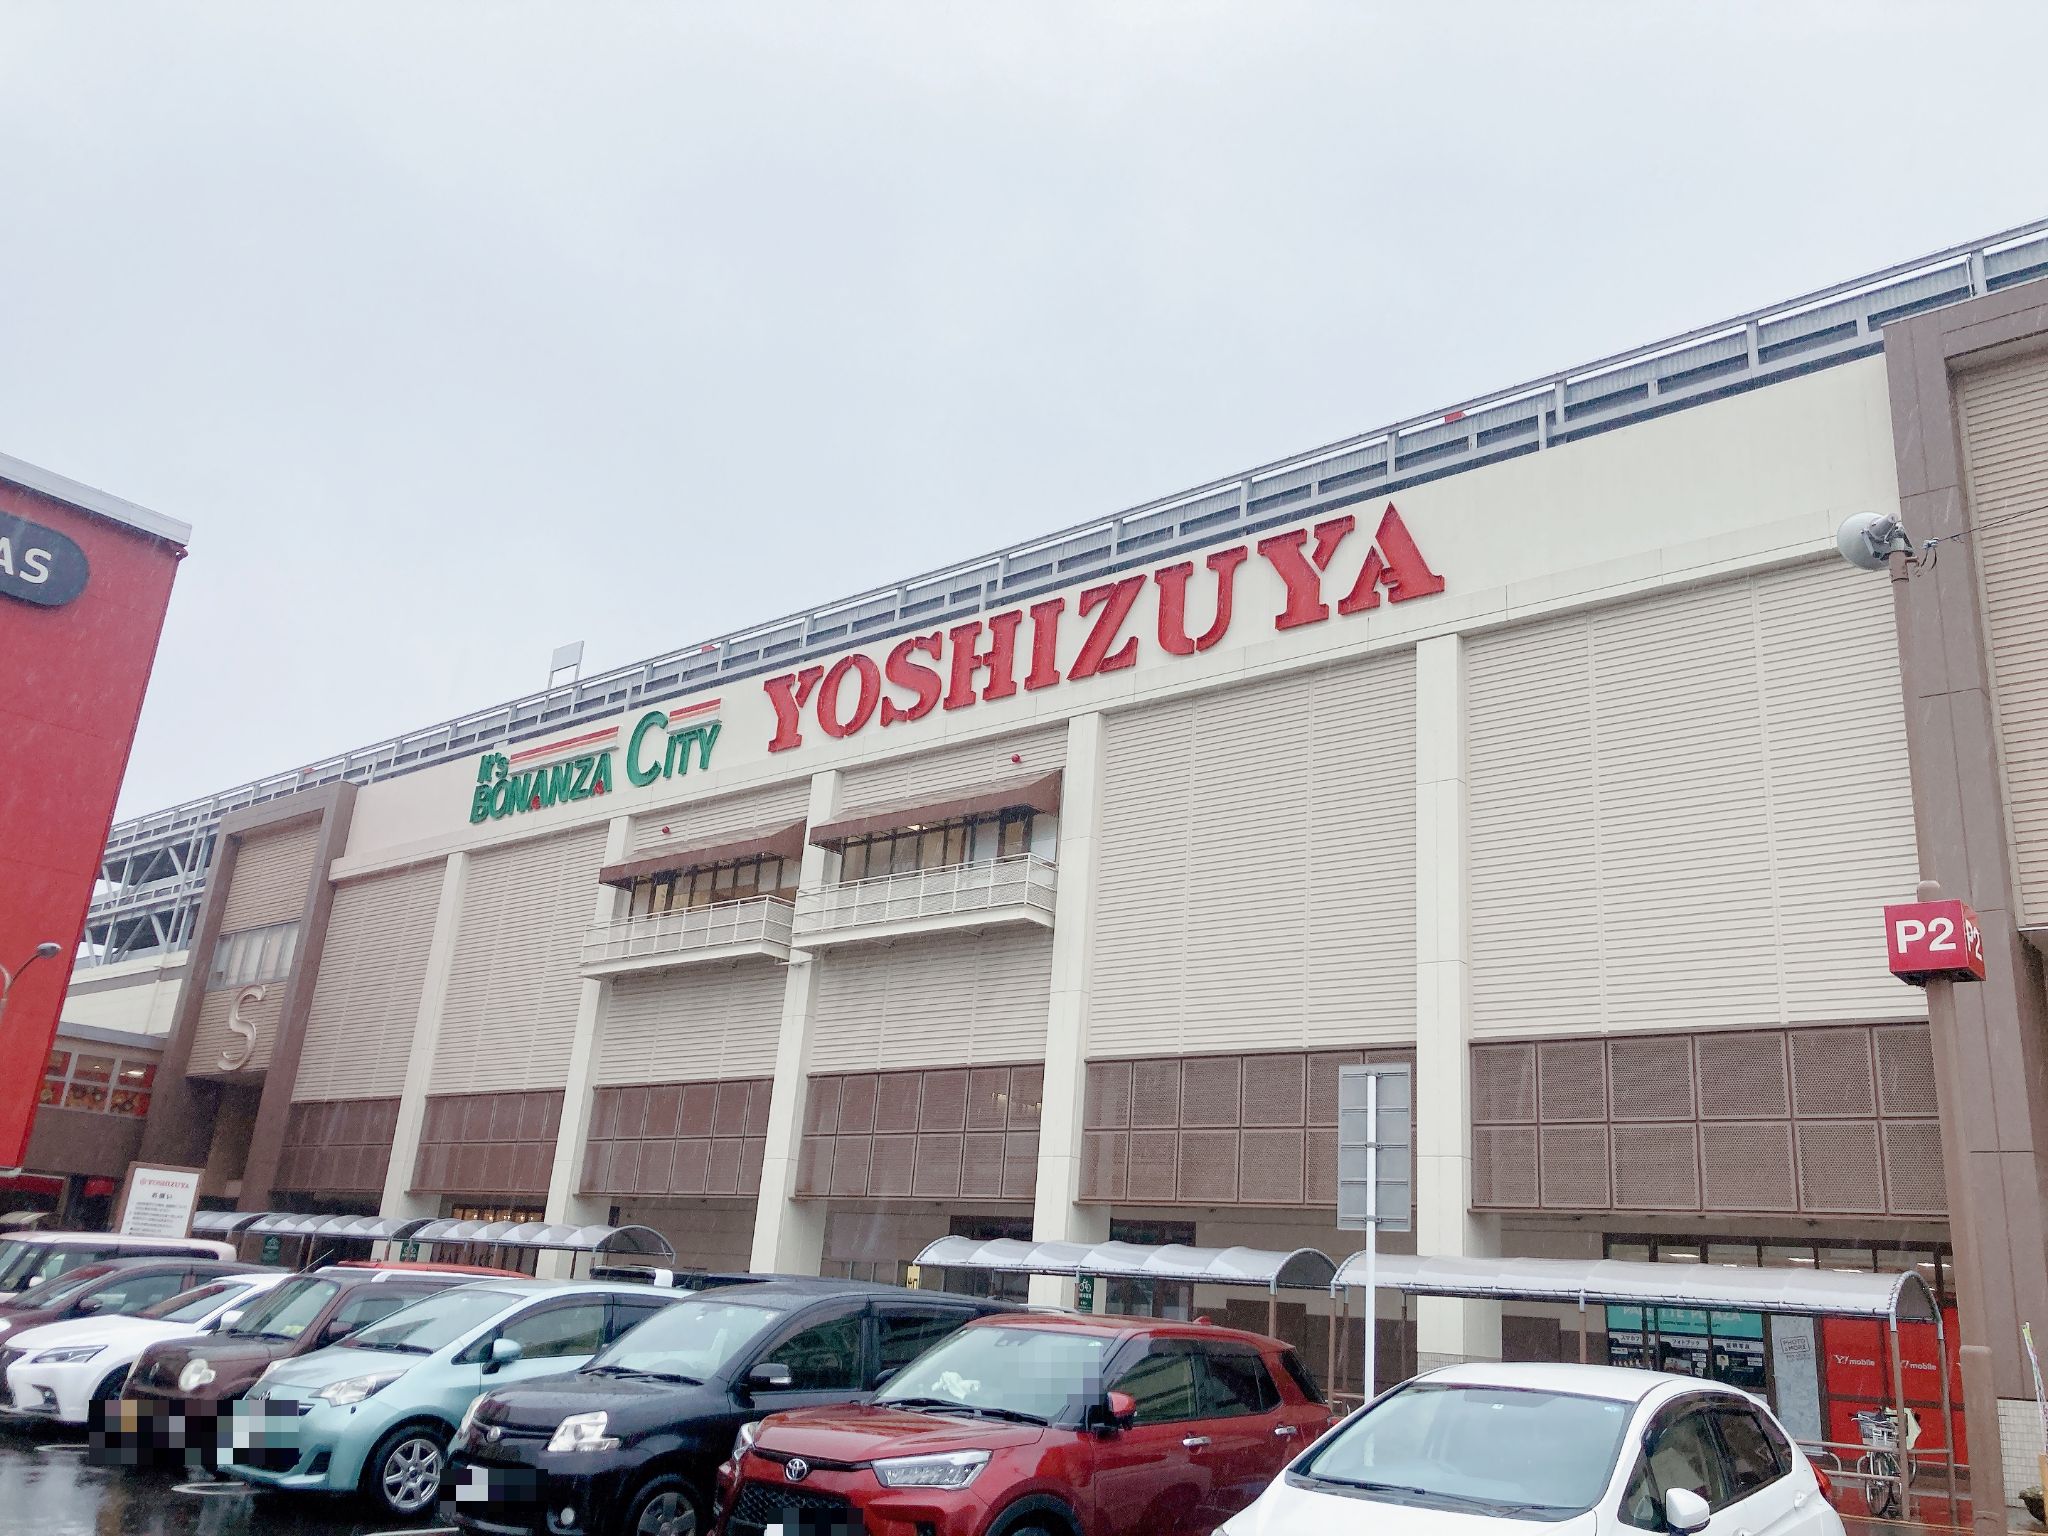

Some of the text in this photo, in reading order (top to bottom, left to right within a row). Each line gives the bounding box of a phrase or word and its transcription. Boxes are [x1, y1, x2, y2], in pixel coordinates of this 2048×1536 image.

[764, 500, 1445, 753] YOSHIZUYA
[470, 752, 613, 824] BONANZA
[1895, 917, 1957, 953] P2
[1965, 918, 1983, 961] P2
[217, 984, 266, 1071] S
